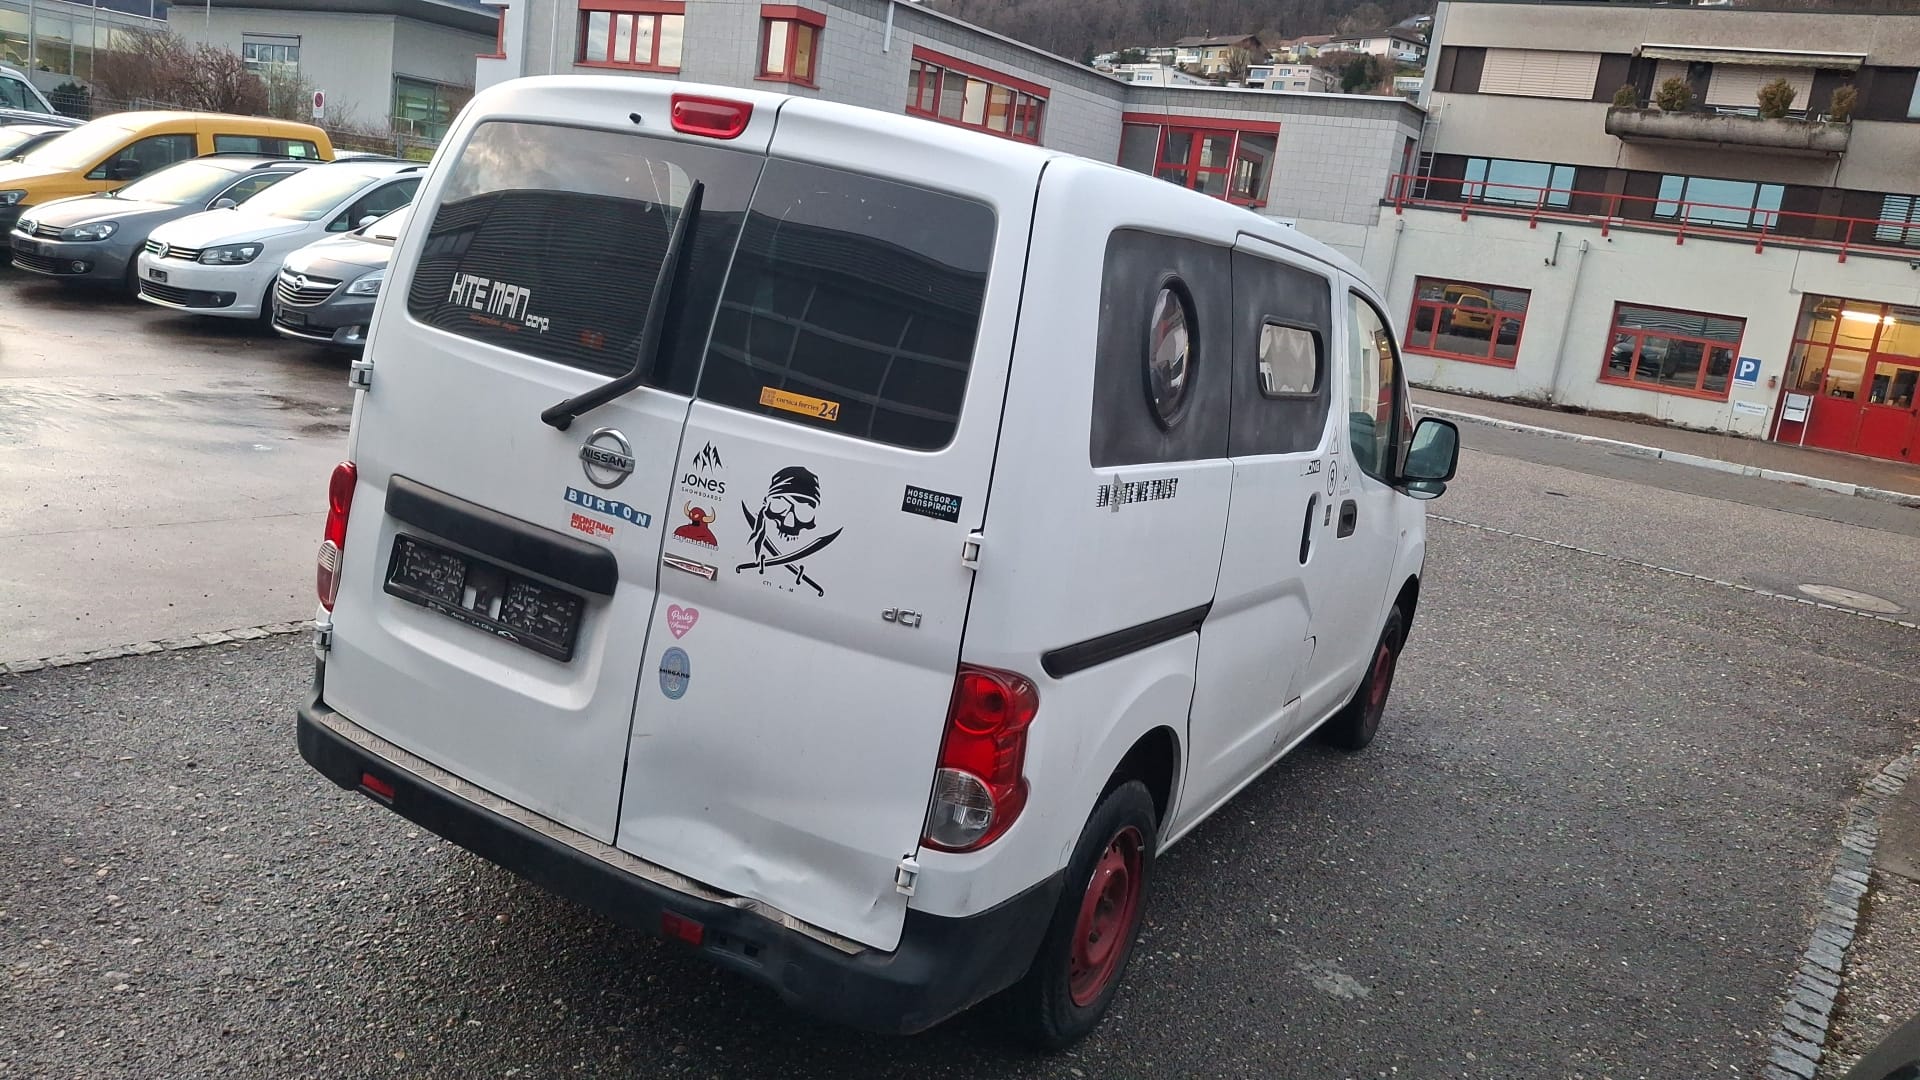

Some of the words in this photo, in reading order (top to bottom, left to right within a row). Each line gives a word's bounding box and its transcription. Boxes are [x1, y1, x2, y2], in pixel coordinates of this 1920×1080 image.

[449, 272, 489, 310] KITE
[1740, 360, 1755, 378] P
[818, 401, 838, 420] 24
[582, 447, 627, 468] NISSAN
[681, 487, 722, 502] SNOWBOARDS
[907, 489, 951, 505] HOSSEGOR
[568, 489, 648, 527] BURTON
[906, 496, 958, 513] CONSPIRACY
[570, 520, 594, 535] CANS
[571, 513, 614, 534] MONTANA
